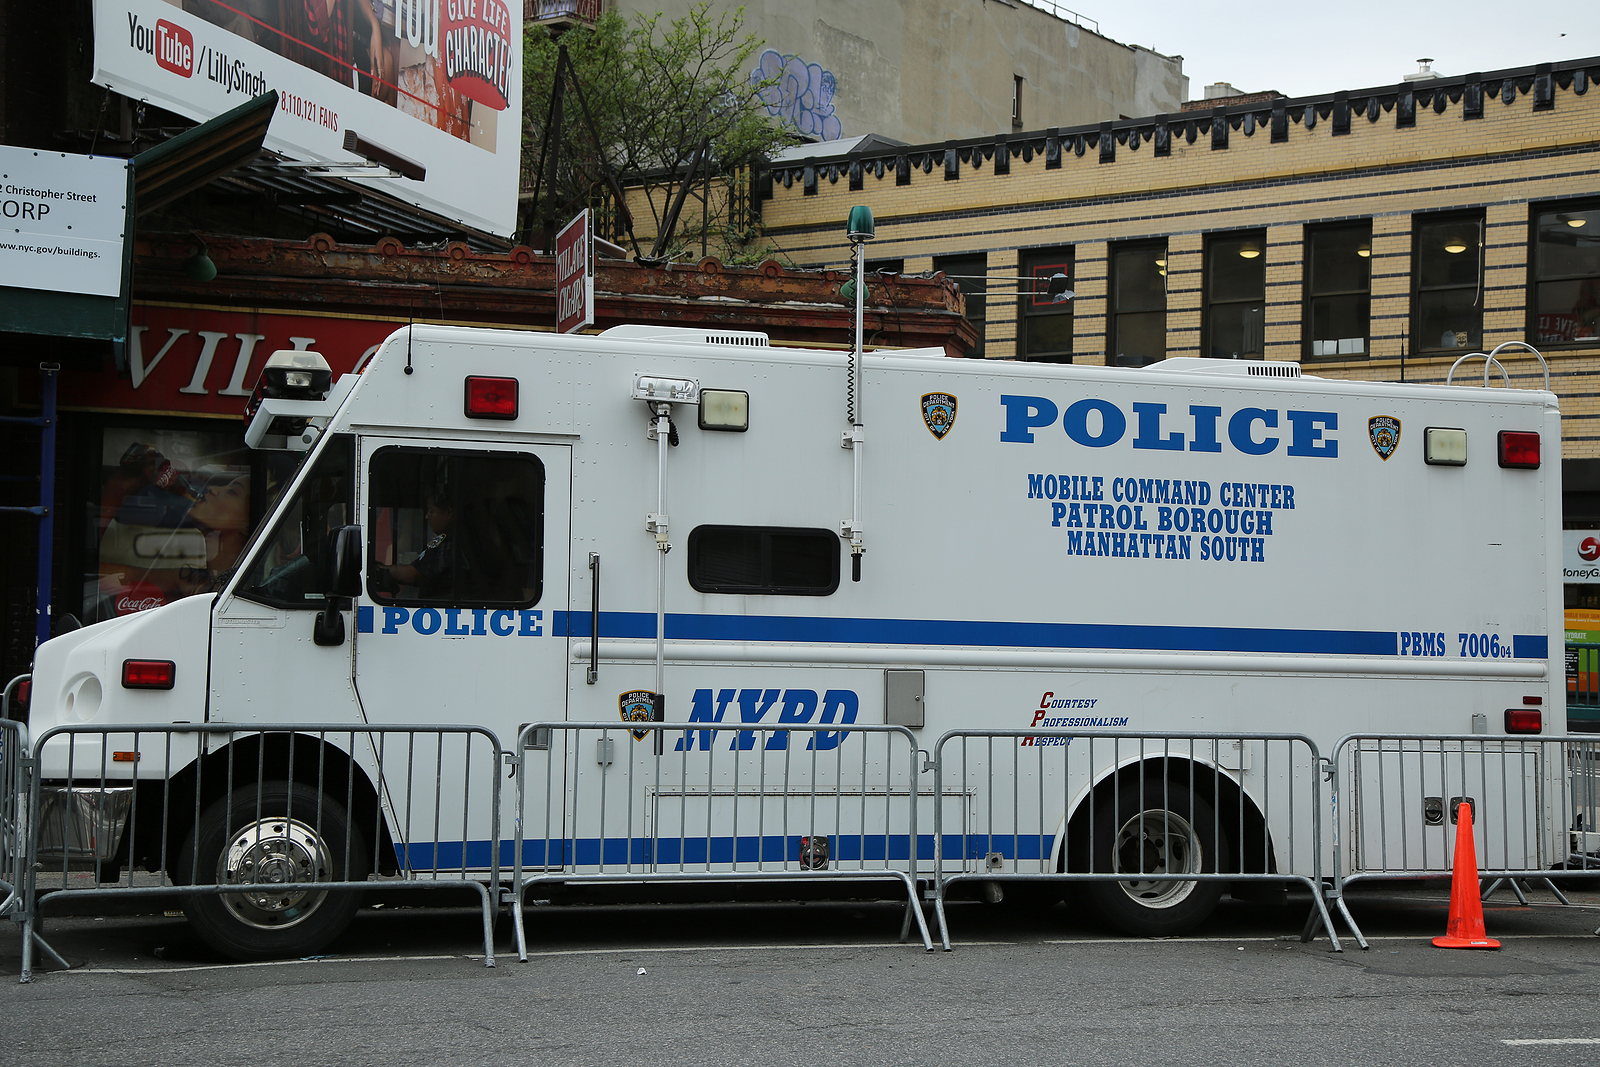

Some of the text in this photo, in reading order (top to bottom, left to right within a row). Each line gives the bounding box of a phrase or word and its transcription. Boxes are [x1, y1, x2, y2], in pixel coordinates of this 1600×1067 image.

[447, 0, 508, 36] GIVE LIFE
[445, 25, 513, 107] CHARACTER
[281, 90, 339, 133] 8,110,121 FANS
[5, 184, 64, 200] Christopher
[66, 191, 97, 203] Street
[0, 200, 50, 221] ORP
[558, 273, 585, 323] CIGARS
[1001, 395, 1339, 459] POLICE
[1028, 474, 1296, 510] MOBILE COMMAND CENTER
[1051, 502, 1273, 536] PATROL BOROUGH
[1067, 530, 1265, 563] MANHATTAN SOUTH
[1563, 567, 1600, 580] oneyG
[382, 606, 544, 637] POLICE
[1400, 632, 1446, 657] PBMS
[1458, 633, 1500, 659] 7006
[621, 698, 655, 708] DEPARTMEN
[1040, 691, 1098, 709] COURTESY
[674, 688, 861, 752] NYPD
[1030, 709, 1129, 728] PROFESSIONALISM
